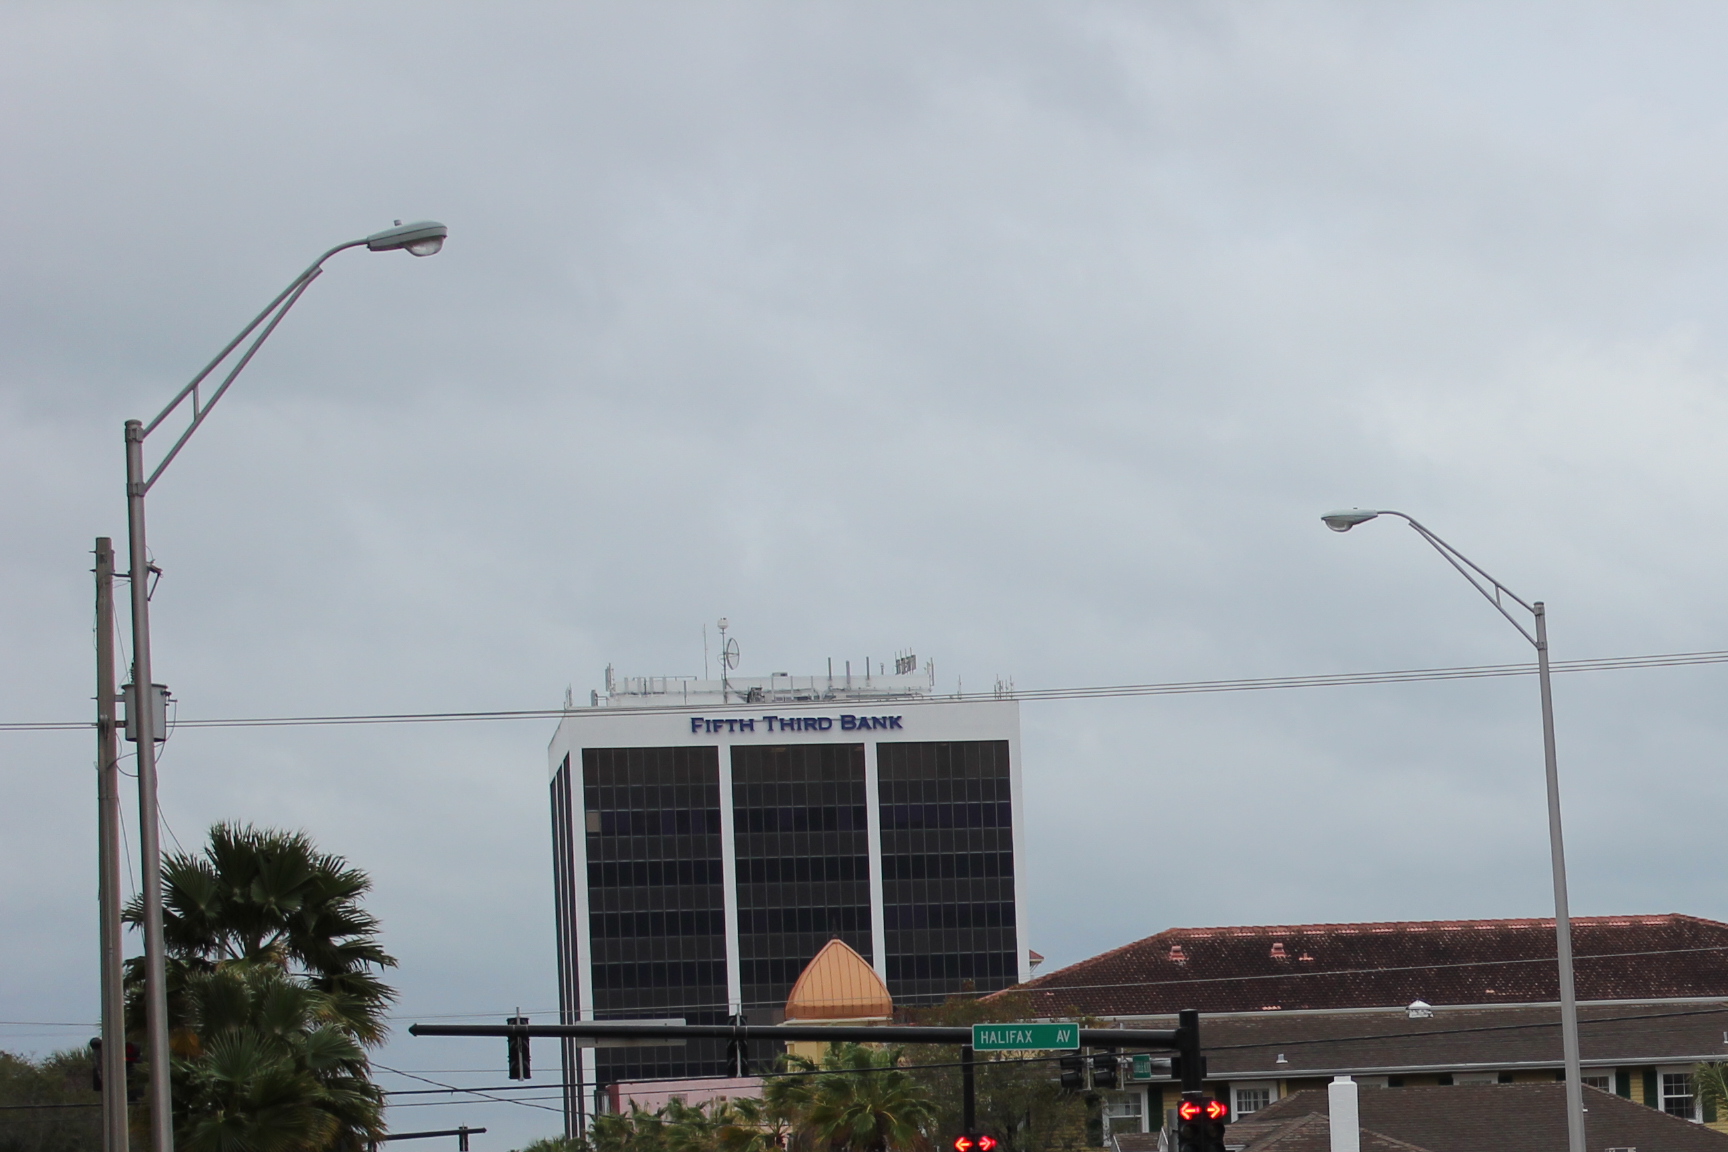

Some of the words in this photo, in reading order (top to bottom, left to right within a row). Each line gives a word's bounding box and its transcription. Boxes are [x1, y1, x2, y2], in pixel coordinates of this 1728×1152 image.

[690, 717, 755, 734] FIFTH
[762, 716, 833, 731] THIRD
[840, 714, 904, 730] BANK
[980, 1031, 1032, 1044] HALIFAX
[1056, 1030, 1070, 1043] AV
